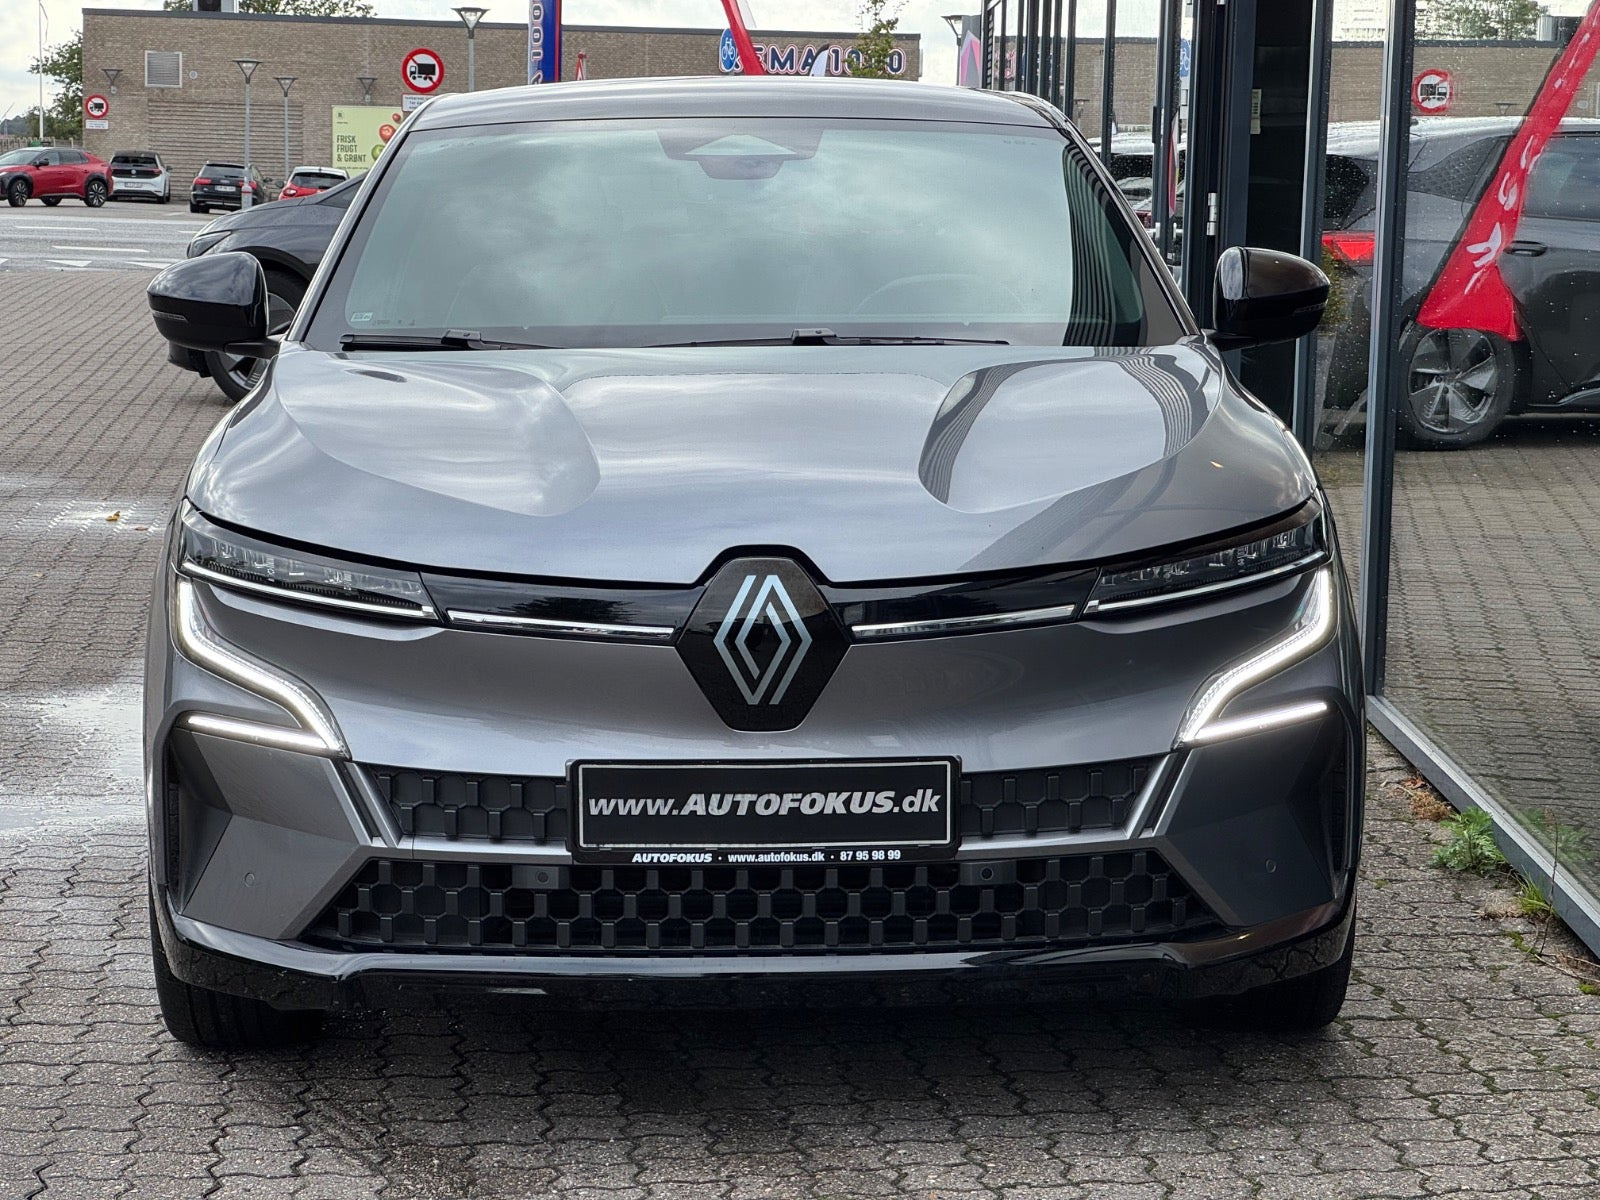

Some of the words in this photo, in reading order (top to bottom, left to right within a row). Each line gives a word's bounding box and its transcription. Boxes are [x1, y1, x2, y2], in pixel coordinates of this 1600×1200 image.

[336, 134, 356, 143] FRISK
[336, 144, 358, 153] FRUGT
[588, 788, 941, 816] www.AUTOFOKUS.dk
[631, 853, 713, 863] AUTOFOKUS
[727, 851, 825, 863] www.autofokus.dk
[839, 851, 852, 861] 87
[855, 850, 869, 861] 95
[871, 850, 885, 861] 98
[887, 849, 902, 861] 99
